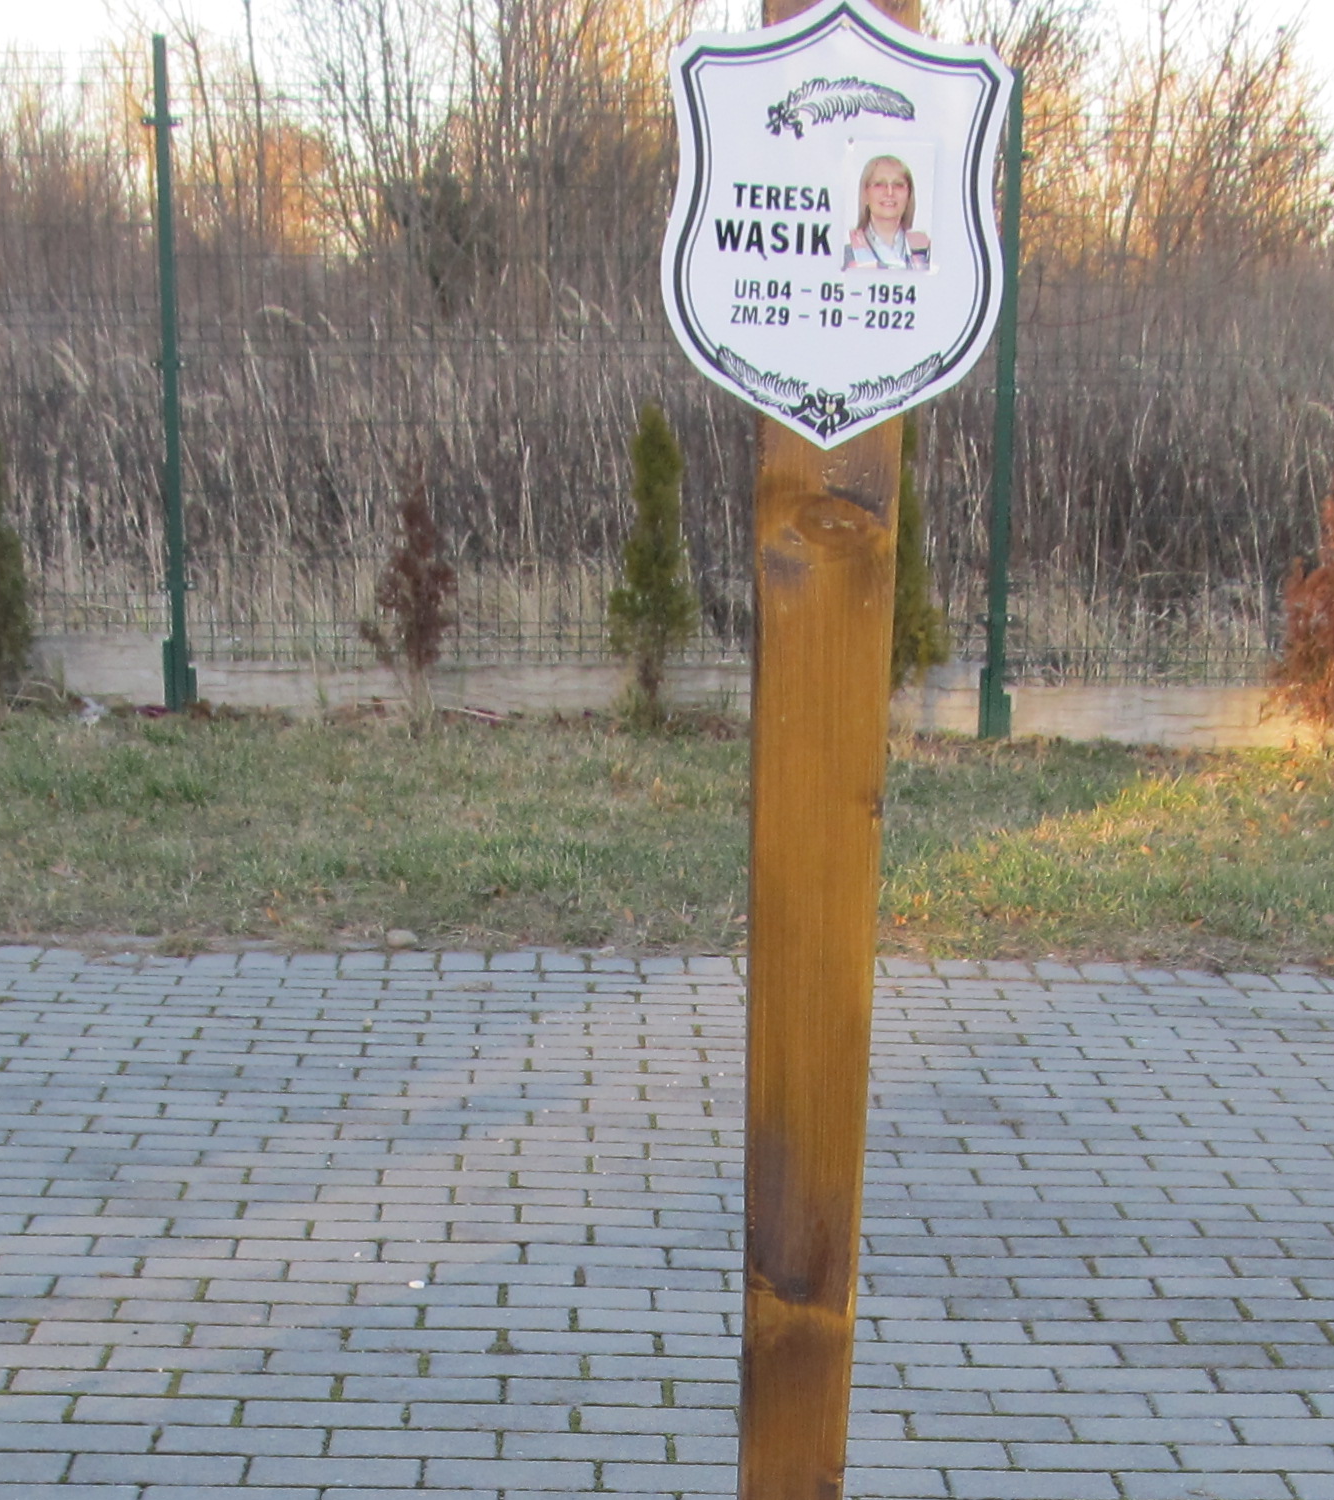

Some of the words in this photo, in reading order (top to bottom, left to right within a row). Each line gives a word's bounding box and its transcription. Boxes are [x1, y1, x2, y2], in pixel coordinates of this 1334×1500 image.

[733, 182, 831, 212] TERESA
[715, 218, 831, 261] WĄSIK
[868, 283, 916, 304] 1954
[865, 309, 915, 330] 2022
